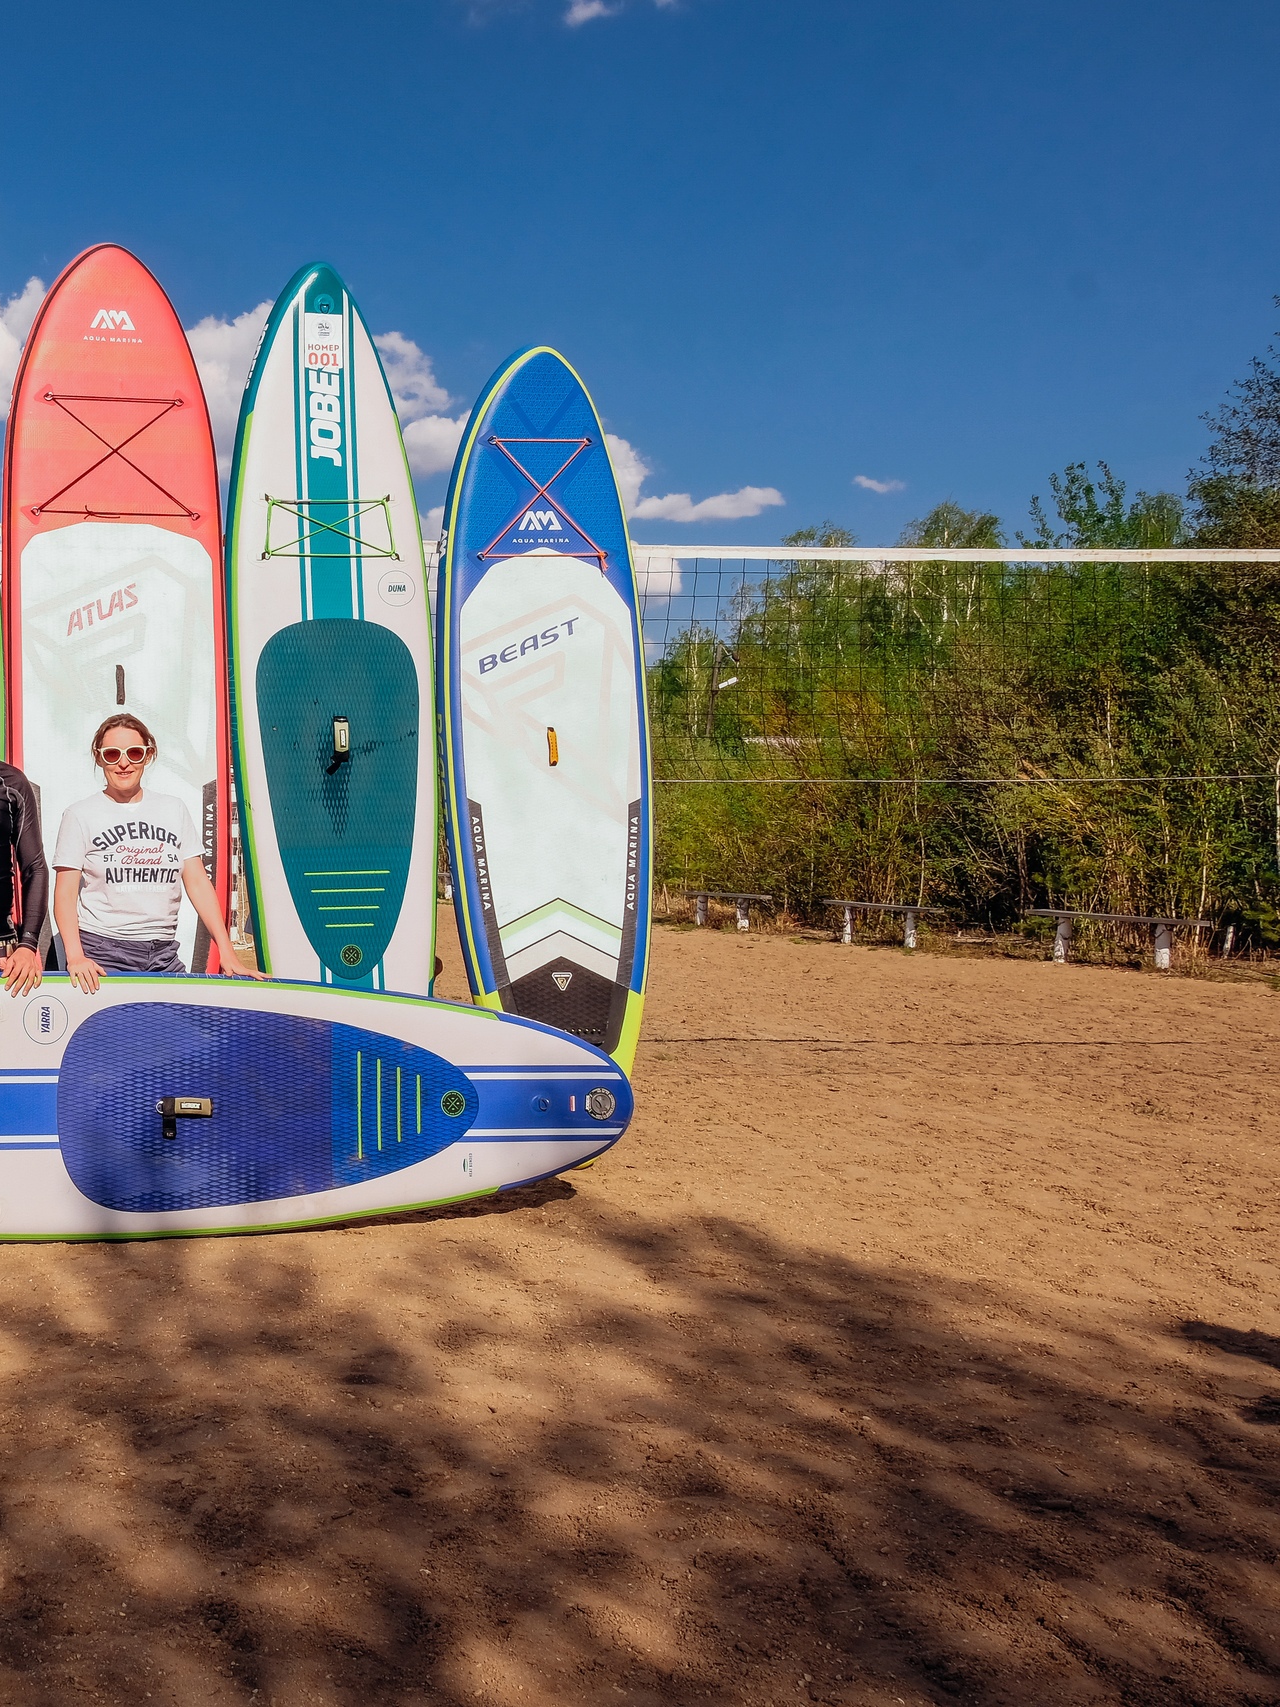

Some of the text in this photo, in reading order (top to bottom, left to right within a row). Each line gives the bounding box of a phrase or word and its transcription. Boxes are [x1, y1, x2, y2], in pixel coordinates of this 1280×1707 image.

[307, 344, 340, 352] НОМЕР
[308, 352, 340, 367] 001
[308, 368, 343, 468] JOBE
[387, 584, 407, 593] DUNA
[66, 583, 139, 637] ATLAS
[478, 616, 580, 675] BEAST
[205, 803, 214, 857] MARINA
[103, 854, 117, 863] ST.
[121, 855, 163, 865] Brand
[115, 843, 164, 857] Original
[471, 816, 493, 911] AQUA MARINA
[626, 816, 639, 911] AQUA MARINA
[105, 867, 180, 884] AUTHENTIC
[41, 1006, 50, 1033] YARRA
